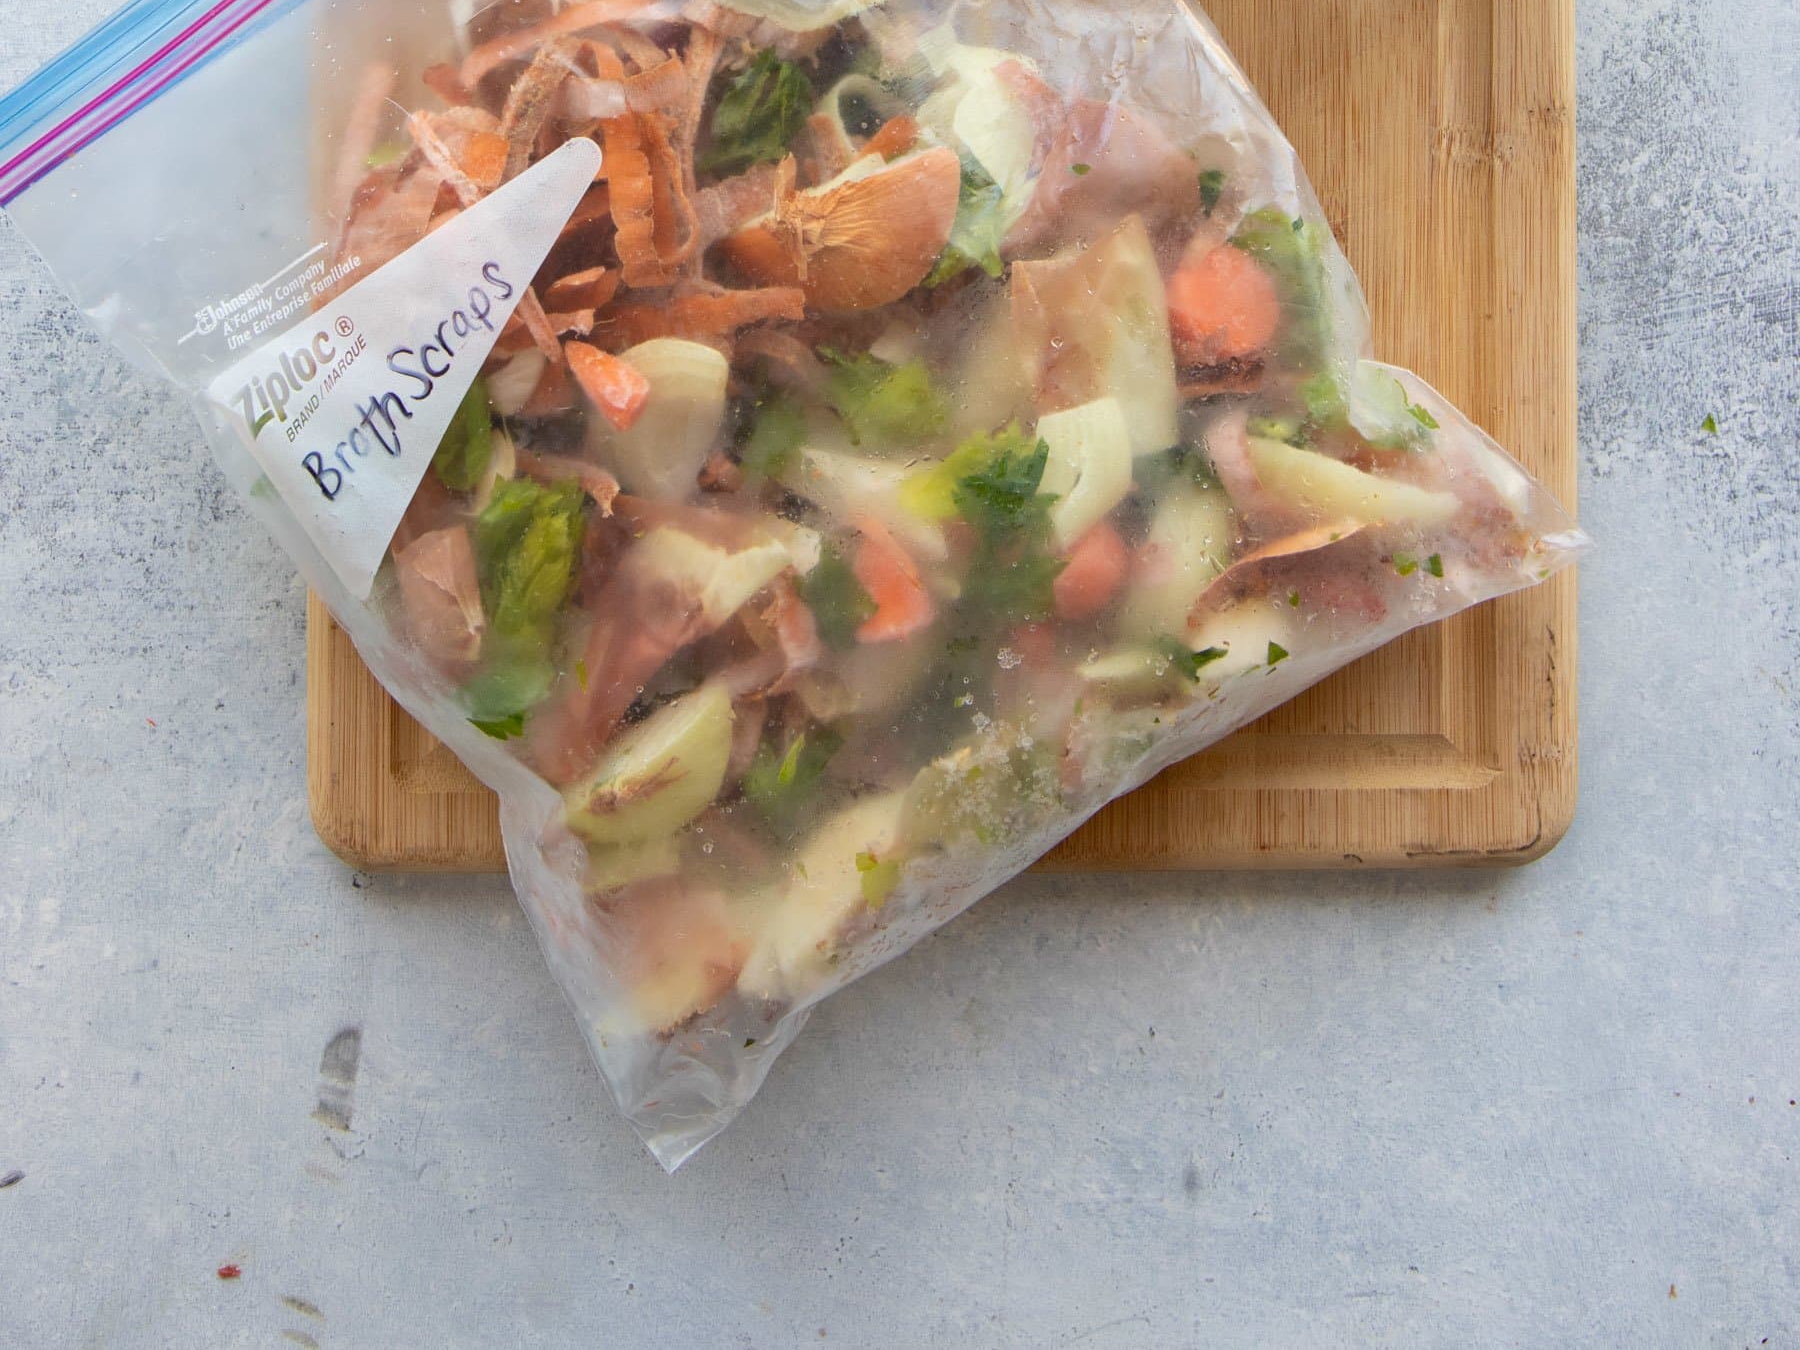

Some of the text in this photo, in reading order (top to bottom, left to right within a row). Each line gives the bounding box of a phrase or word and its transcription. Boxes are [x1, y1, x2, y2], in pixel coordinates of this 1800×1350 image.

[197, 282, 264, 335] Johnson
[222, 258, 327, 337] A Family Company
[226, 254, 362, 350] Une Entreprise Familiale
